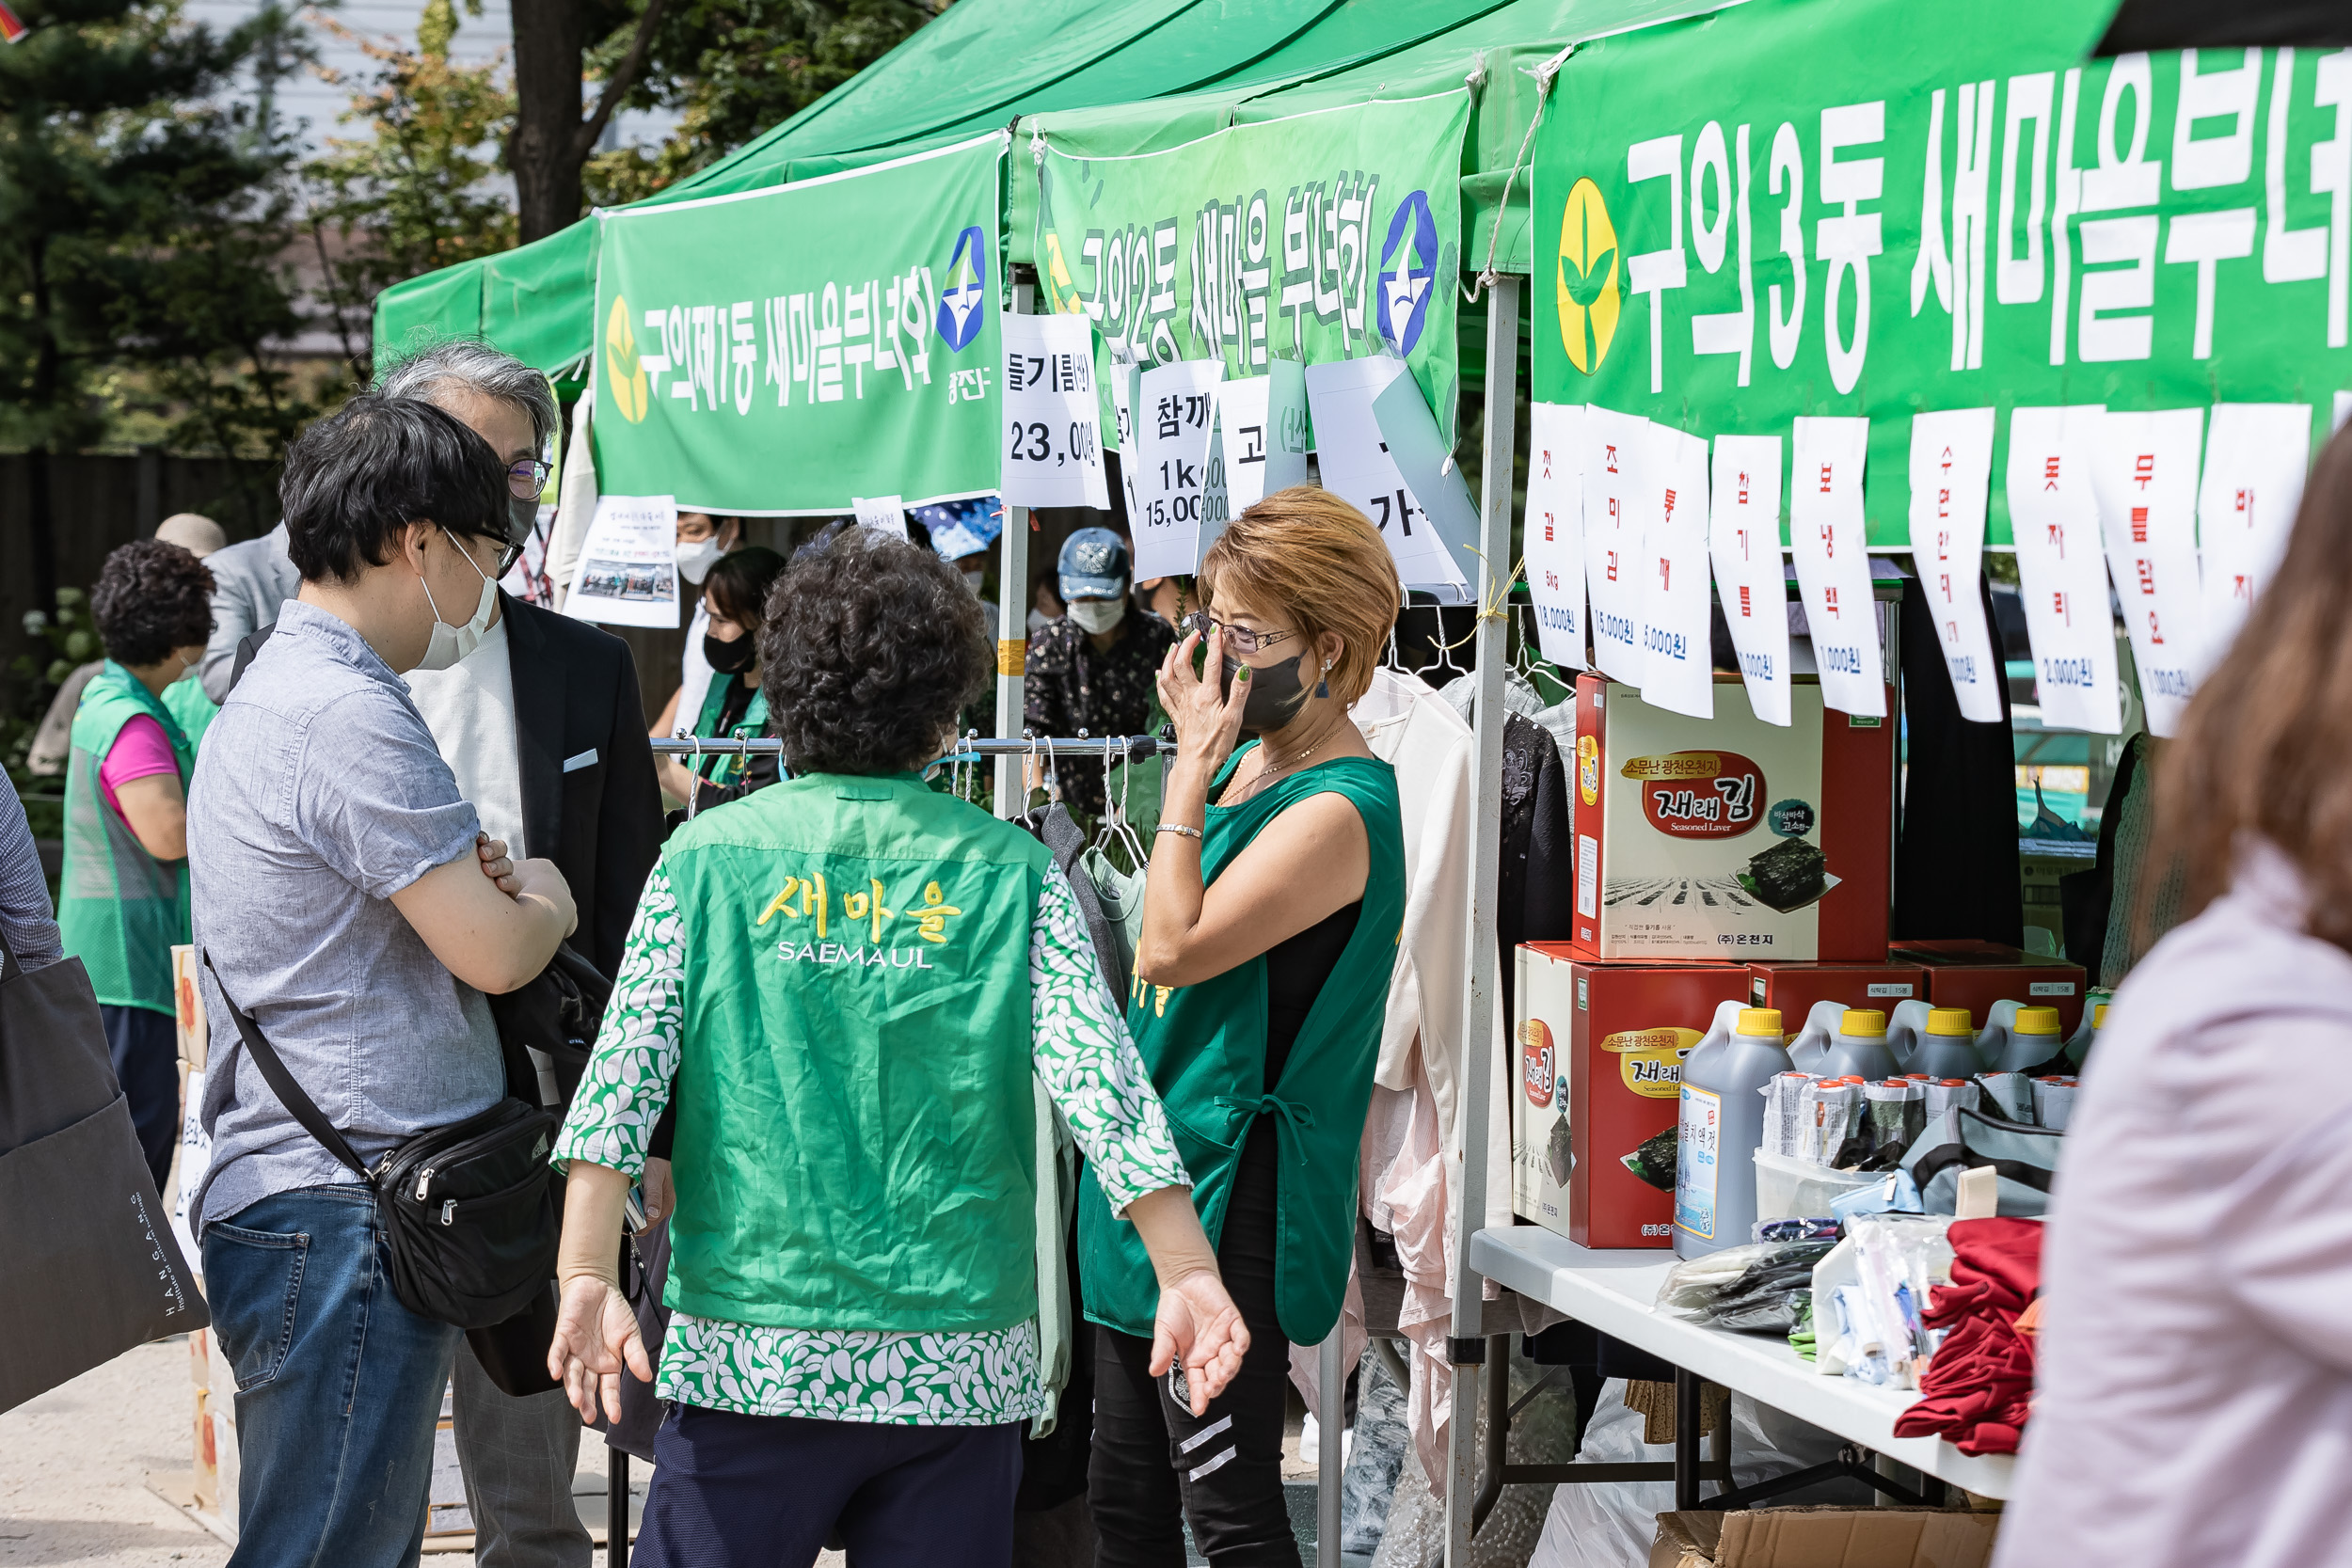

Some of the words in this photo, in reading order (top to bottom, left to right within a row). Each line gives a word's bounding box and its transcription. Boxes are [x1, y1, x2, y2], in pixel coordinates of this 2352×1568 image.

[1628, 99, 1885, 396] 구의3동
[1080, 217, 1183, 367] 구의2동
[1190, 188, 1270, 374] 새마을
[1279, 170, 1379, 361] 부녀회
[640, 301, 757, 416] 구의제1동
[765, 265, 936, 407] 새마을부녀회
[1606, 444, 1620, 582] 조미김
[1737, 471, 1752, 617] 참기름
[2044, 457, 2071, 627] 돗자리
[2130, 454, 2165, 645] 무릎담요
[1546, 570, 1559, 591] 5kg
[1538, 605, 1575, 634] 18,000원
[1596, 610, 1633, 645] 15,000원
[2043, 658, 2093, 688] 2,000원
[1627, 760, 1661, 776] 소문난
[1661, 759, 1718, 775] 광천온천지
[1653, 773, 1756, 822] 재래김
[1671, 822, 1708, 832] Seasoned
[1709, 823, 1732, 832] Laver
[1773, 809, 1805, 821] 바삭바삭
[756, 871, 961, 943] 새마을
[777, 941, 933, 969] SAEMAUL
[1717, 933, 1773, 945] (주)온천지
[1607, 1036, 1632, 1047] 소문난
[1634, 1034, 1675, 1047] 광천온천지
[1629, 1048, 1692, 1083] 재래
[150, 1229, 167, 1262] cultural
[1641, 1224, 1674, 1236] (주)온
[165, 1264, 172, 1274] of
[170, 1275, 185, 1312] Institute
